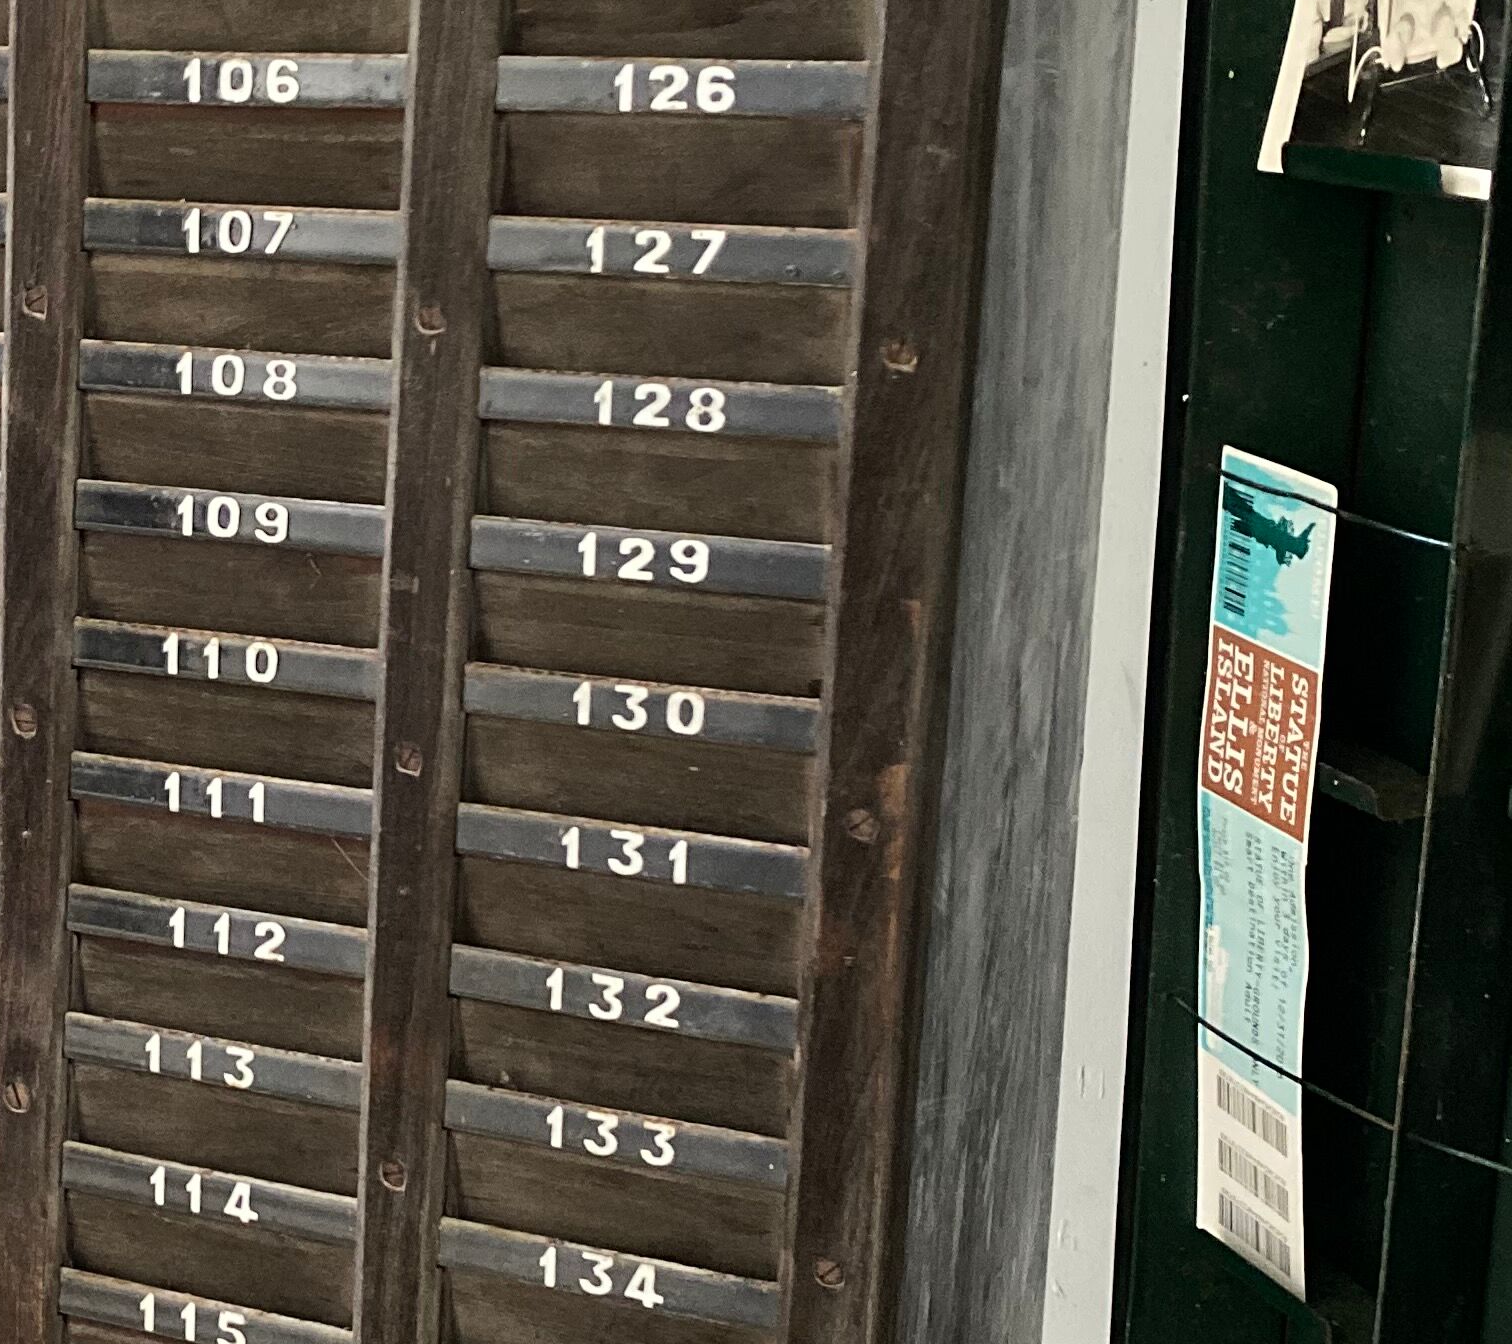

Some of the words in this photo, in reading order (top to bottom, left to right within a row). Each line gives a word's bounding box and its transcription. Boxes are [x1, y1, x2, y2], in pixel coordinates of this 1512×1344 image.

[614, 63, 736, 113] 126
[182, 207, 294, 255] 107
[586, 227, 725, 275] 127
[175, 351, 297, 401] 108
[593, 380, 726, 433] 128
[177, 495, 289, 544] 109
[572, 681, 705, 736] 130
[1206, 636, 1233, 786] ISLAND
[1258, 658, 1270, 724] NATIONAL
[1222, 644, 1254, 798] ELLIS
[1248, 719, 1257, 736] &
[1257, 661, 1285, 814] LIBERTY
[1278, 671, 1309, 826] STATUE
[1250, 725, 1263, 806] MONUMENT
[164, 771, 265, 823] 111
[561, 826, 688, 885] 131
[168, 907, 286, 962] 112
[545, 967, 681, 1028] 132
[145, 1033, 255, 1089] 113
[539, 1246, 664, 1308] 134
